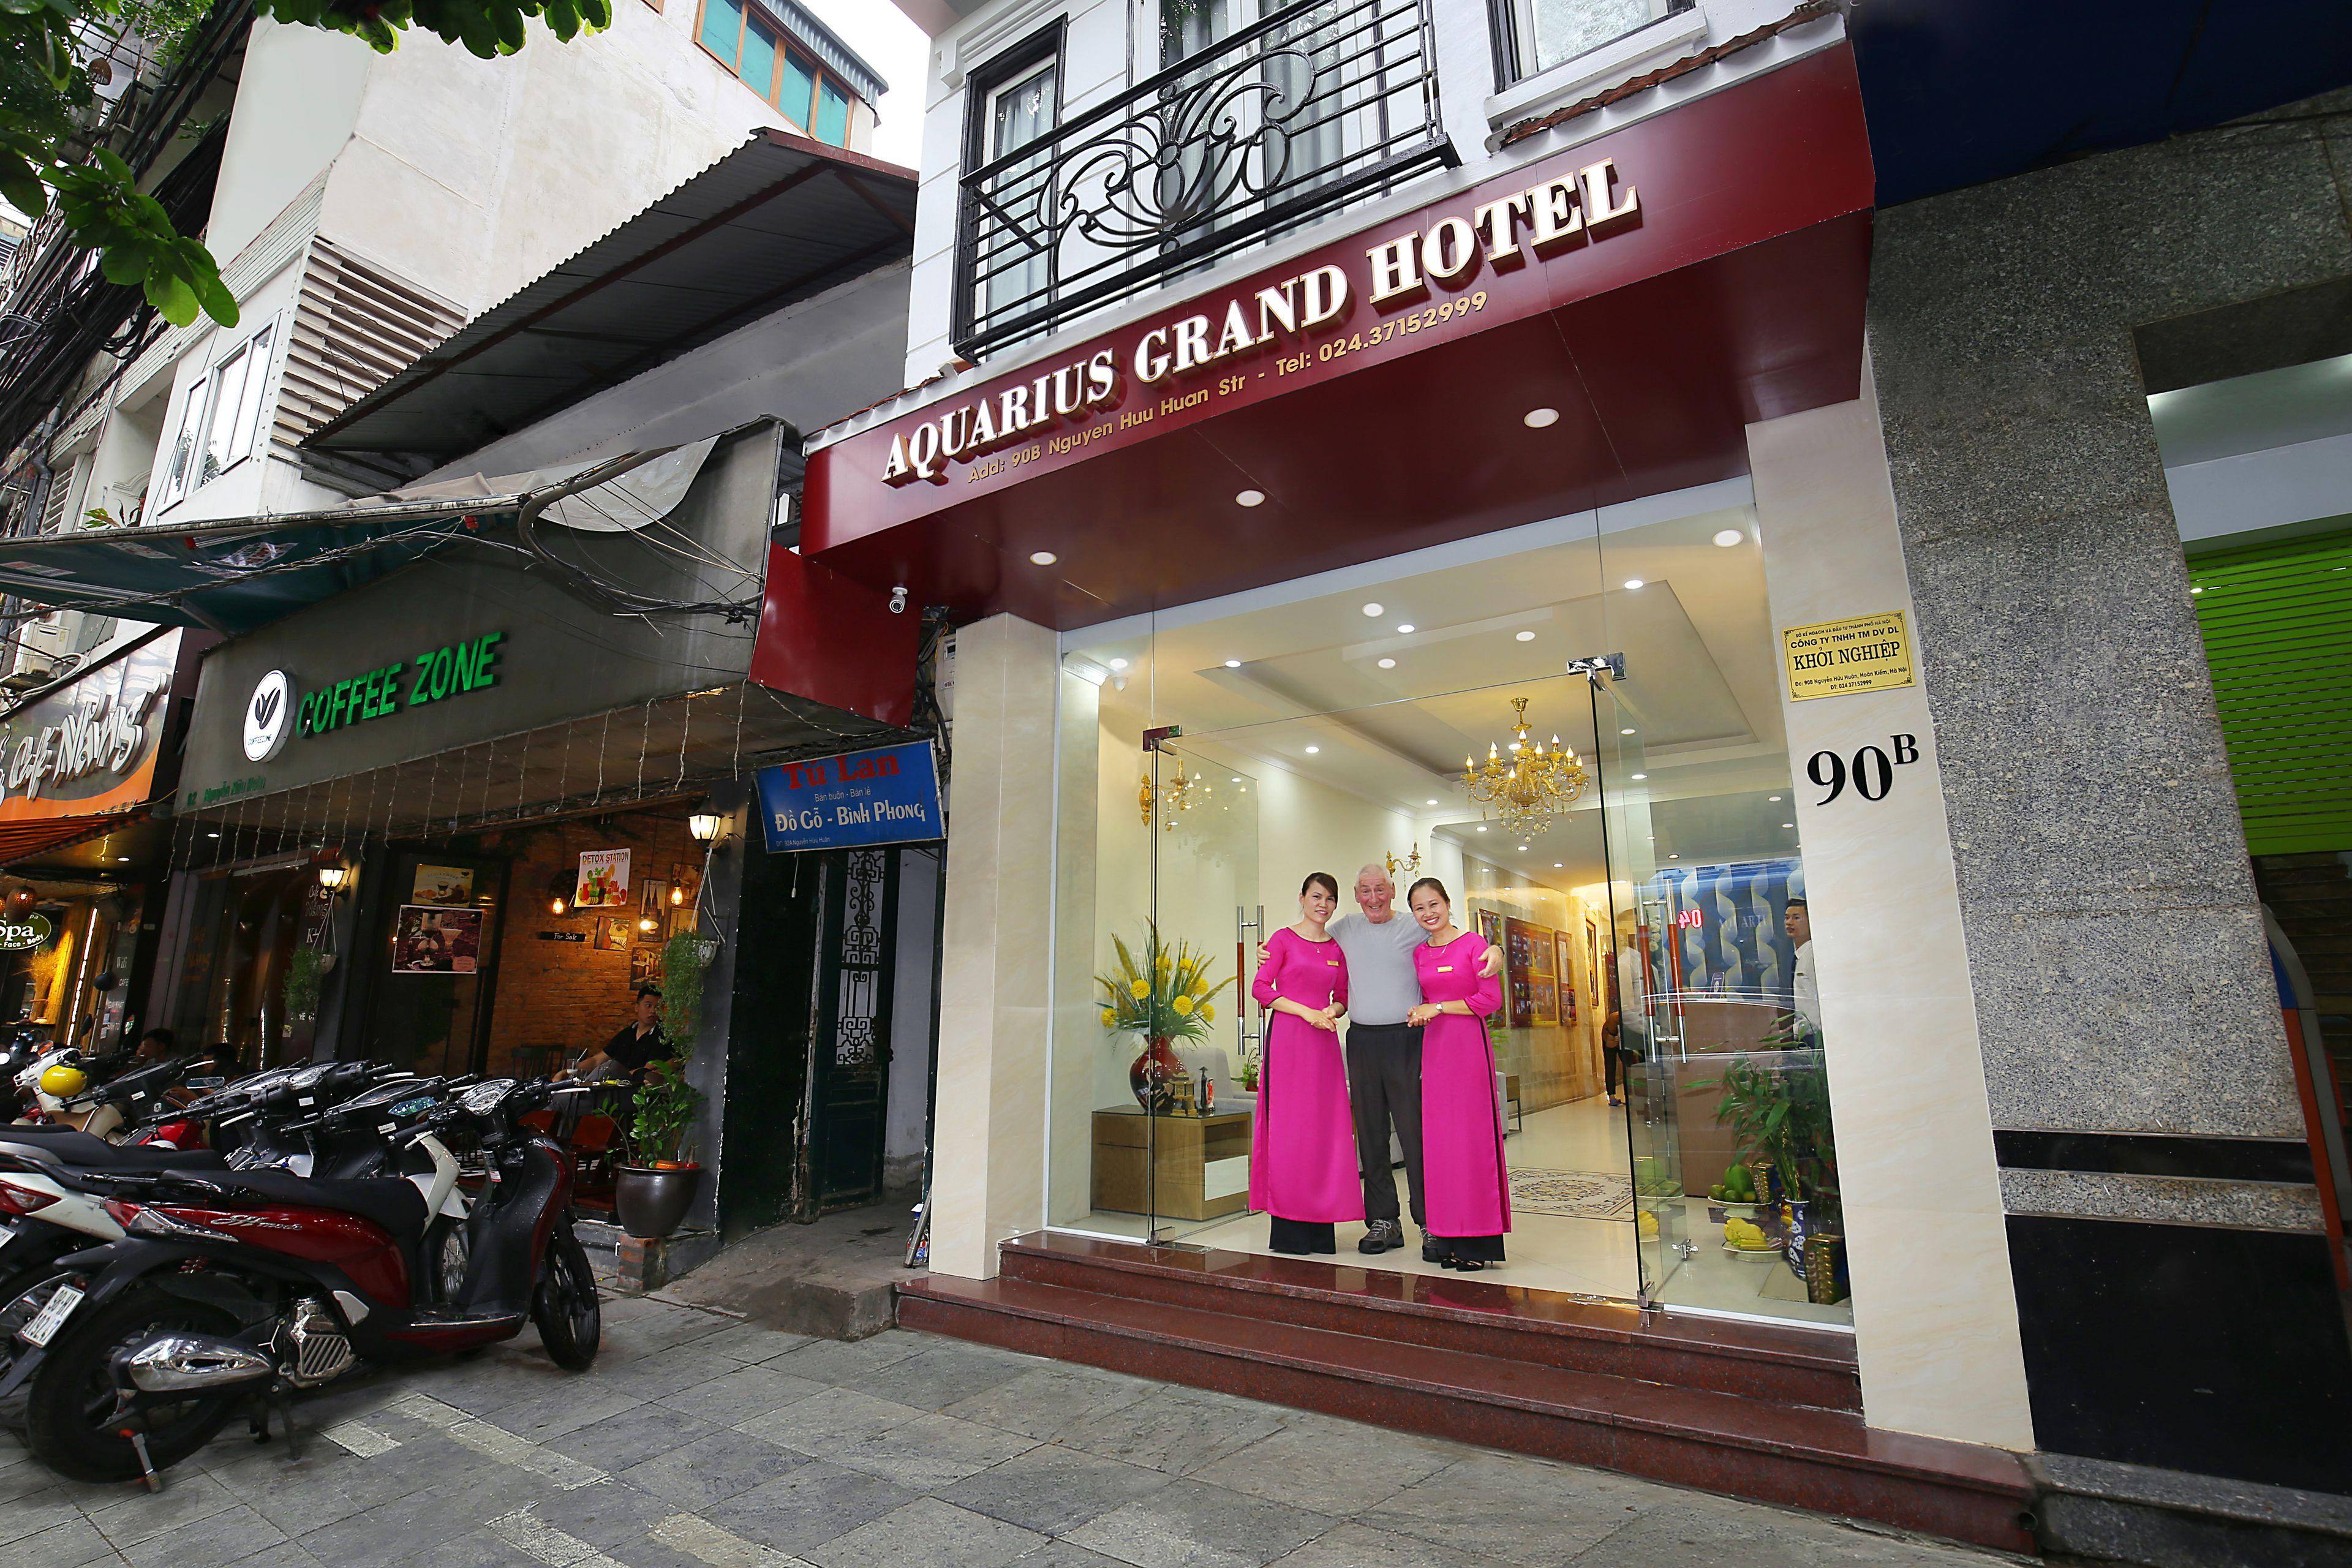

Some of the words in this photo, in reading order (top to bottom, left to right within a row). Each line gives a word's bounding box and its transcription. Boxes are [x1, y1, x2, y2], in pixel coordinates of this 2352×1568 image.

[881, 348, 1115, 483] AQUARIUS
[1134, 264, 1349, 383] GRAND
[1365, 157, 1638, 304] HOTEL
[968, 459, 1006, 483] Add:
[1012, 445, 1041, 468] 90B
[1048, 422, 1114, 454] Nguyen
[1120, 407, 1154, 431] Huu
[1161, 387, 1208, 417] Huan
[1218, 374, 1246, 396] Str
[1276, 352, 1312, 377] Tel:
[1319, 291, 1488, 363] 024.37152999
[1790, 637, 1818, 649] CÔNG
[1819, 636, 1830, 645] TY
[1831, 632, 1856, 643] TNHH
[1857, 630, 1870, 639] TM
[1872, 627, 1885, 636] DV
[1888, 625, 1899, 635] DL
[1793, 646, 1834, 671] KHỞI
[1838, 638, 1901, 665] NGHIỆP
[295, 663, 403, 739] COFFEE
[409, 631, 505, 706] ZONE
[835, 754, 901, 783] Lan
[815, 793, 827, 802] Bán
[829, 791, 845, 801] buôn
[775, 809, 797, 832] Đồ
[800, 807, 823, 830] Gỗ
[582, 853, 605, 864] DETOX
[606, 851, 629, 864] STATION
[26, 933, 43, 945] Body
